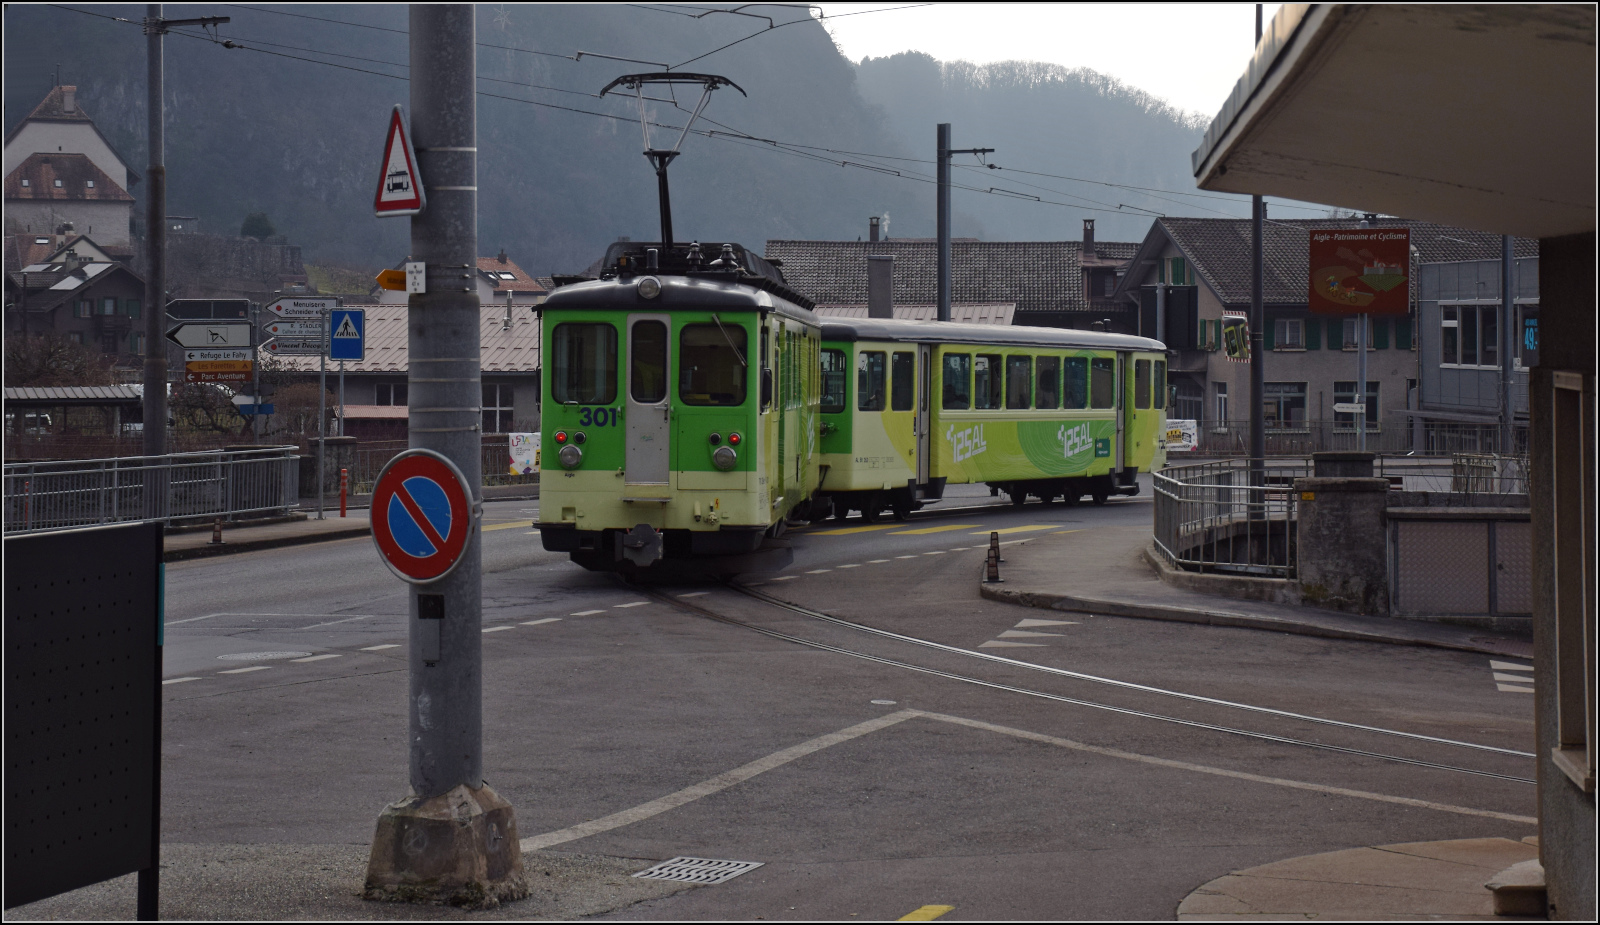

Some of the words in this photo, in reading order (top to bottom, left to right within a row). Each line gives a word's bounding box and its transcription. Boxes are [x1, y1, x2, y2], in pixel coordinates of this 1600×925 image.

[1378, 232, 1407, 241] Cyclisme
[200, 352, 222, 360] Refuge
[232, 352, 247, 360] Fahy
[198, 361, 207, 369] Les
[210, 361, 236, 369] Farettes
[217, 372, 246, 380] Aventure
[579, 406, 617, 427] 301
